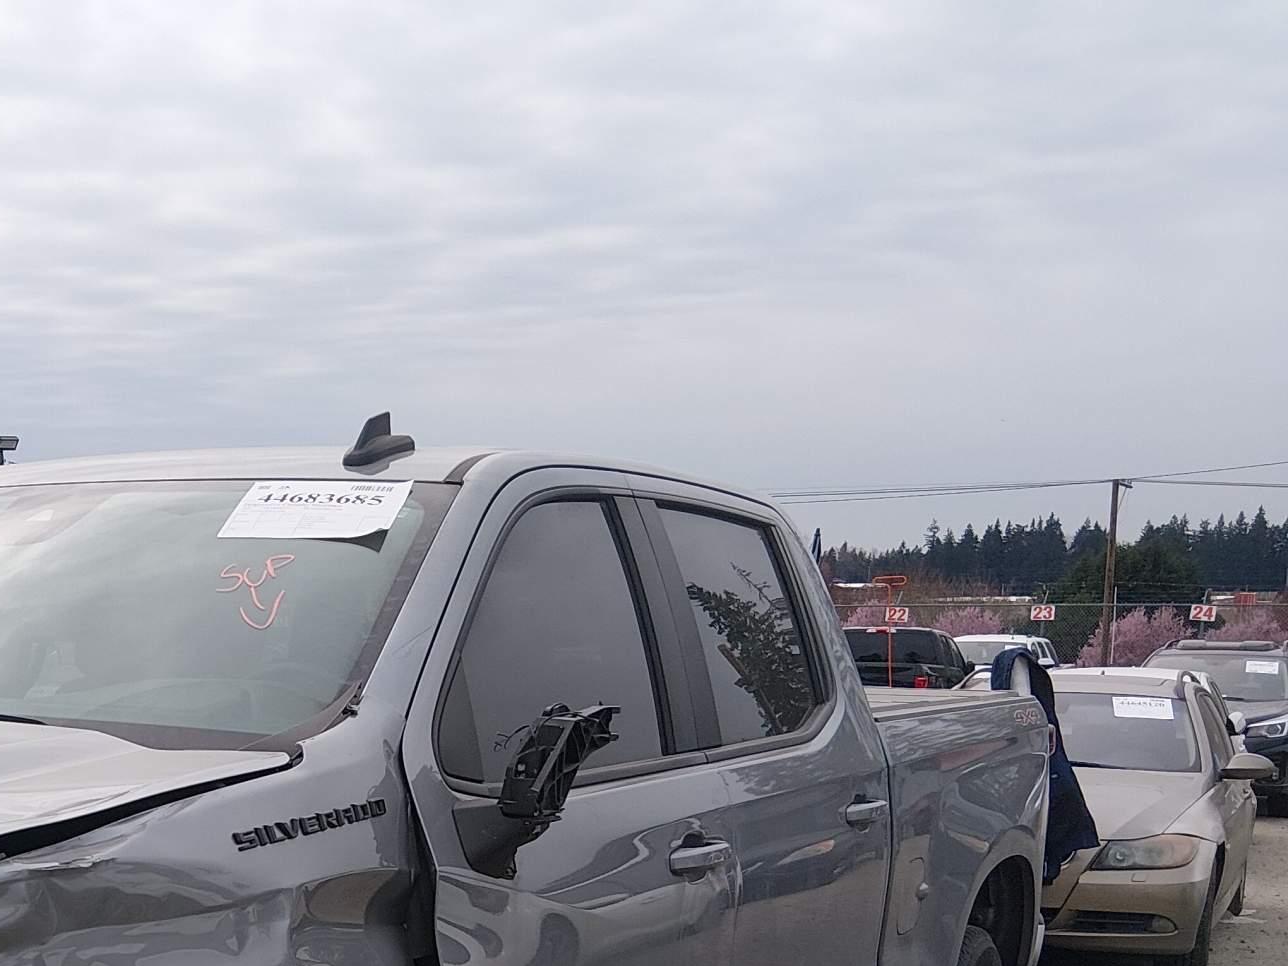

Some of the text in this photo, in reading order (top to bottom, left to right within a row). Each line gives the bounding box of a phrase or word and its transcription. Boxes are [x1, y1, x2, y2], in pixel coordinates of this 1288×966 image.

[258, 493, 385, 506] 44683685
[888, 607, 906, 621] 22
[1032, 606, 1054, 620] 23
[1192, 605, 1214, 621] 24
[231, 798, 387, 852] SILVERADO
